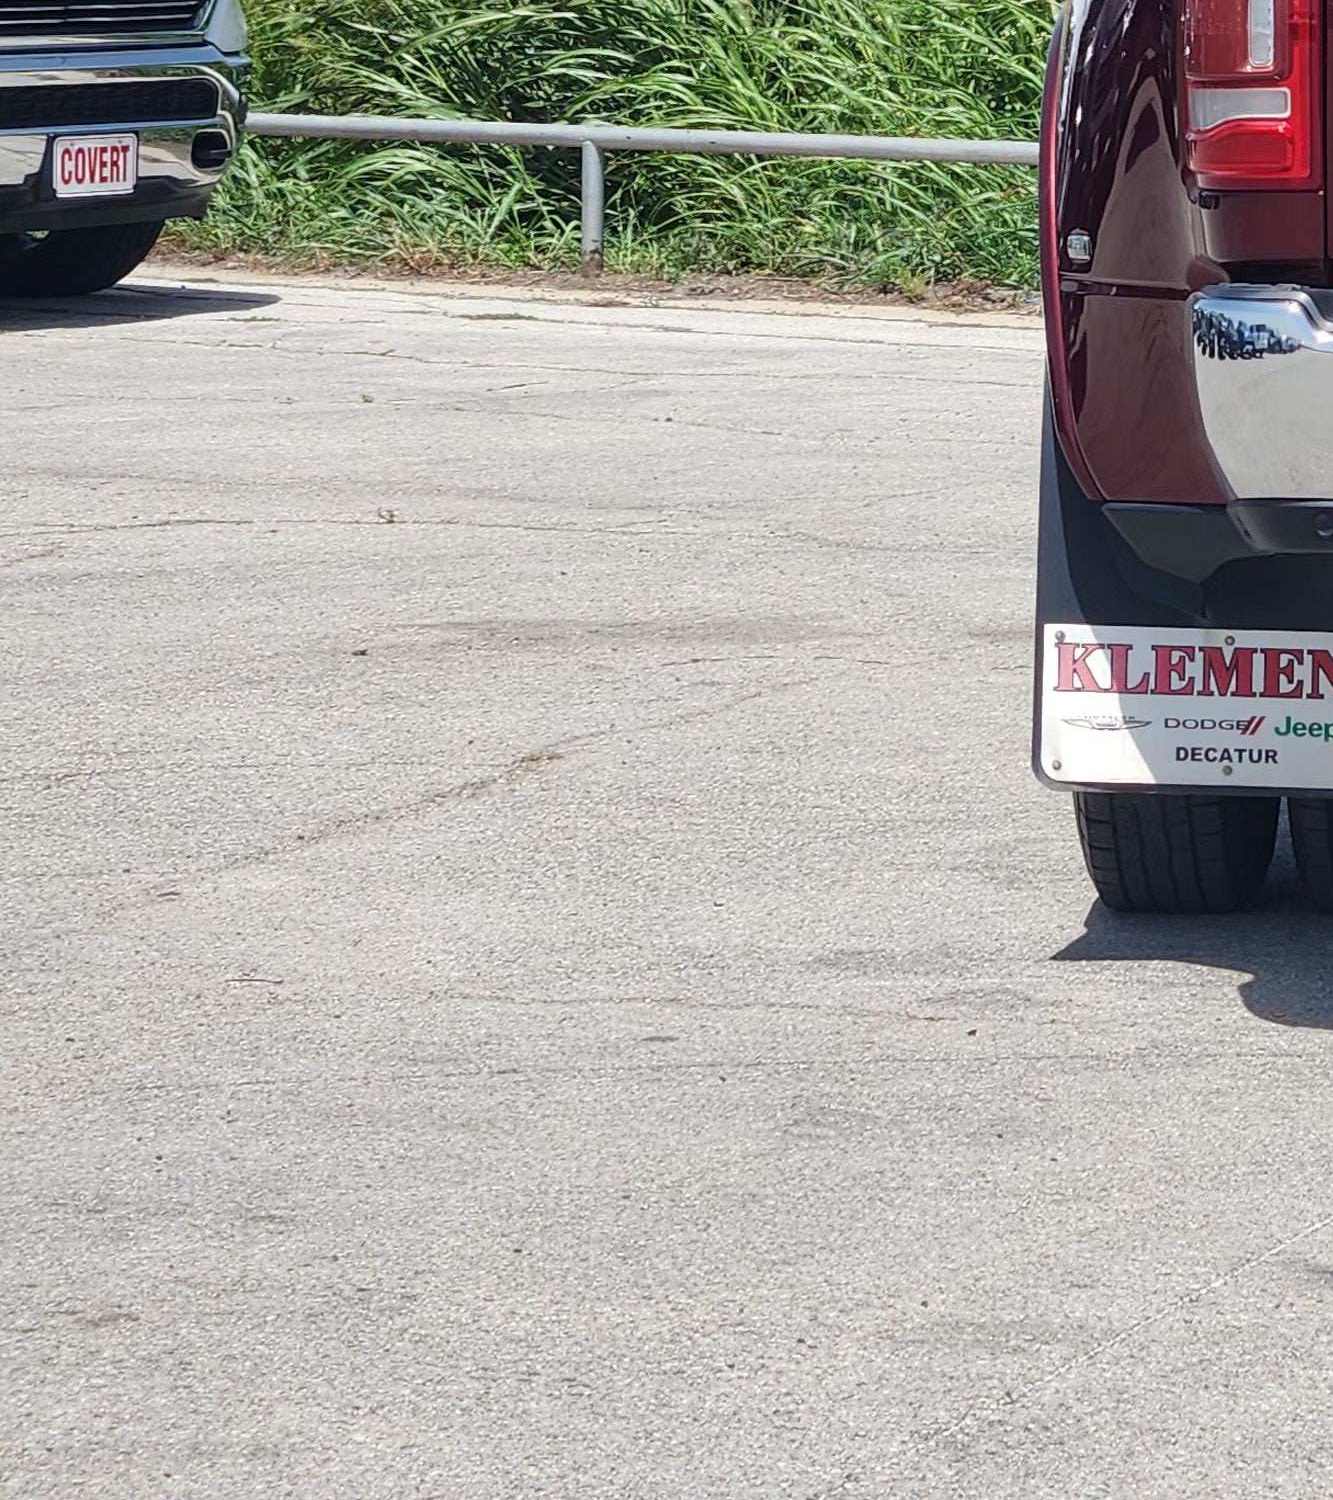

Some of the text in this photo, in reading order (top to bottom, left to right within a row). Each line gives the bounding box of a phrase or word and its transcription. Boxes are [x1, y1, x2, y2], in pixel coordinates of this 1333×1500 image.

[61, 144, 130, 186] COVERT
[1164, 716, 1247, 731] DODGE
[1175, 746, 1279, 765] DECATUR
